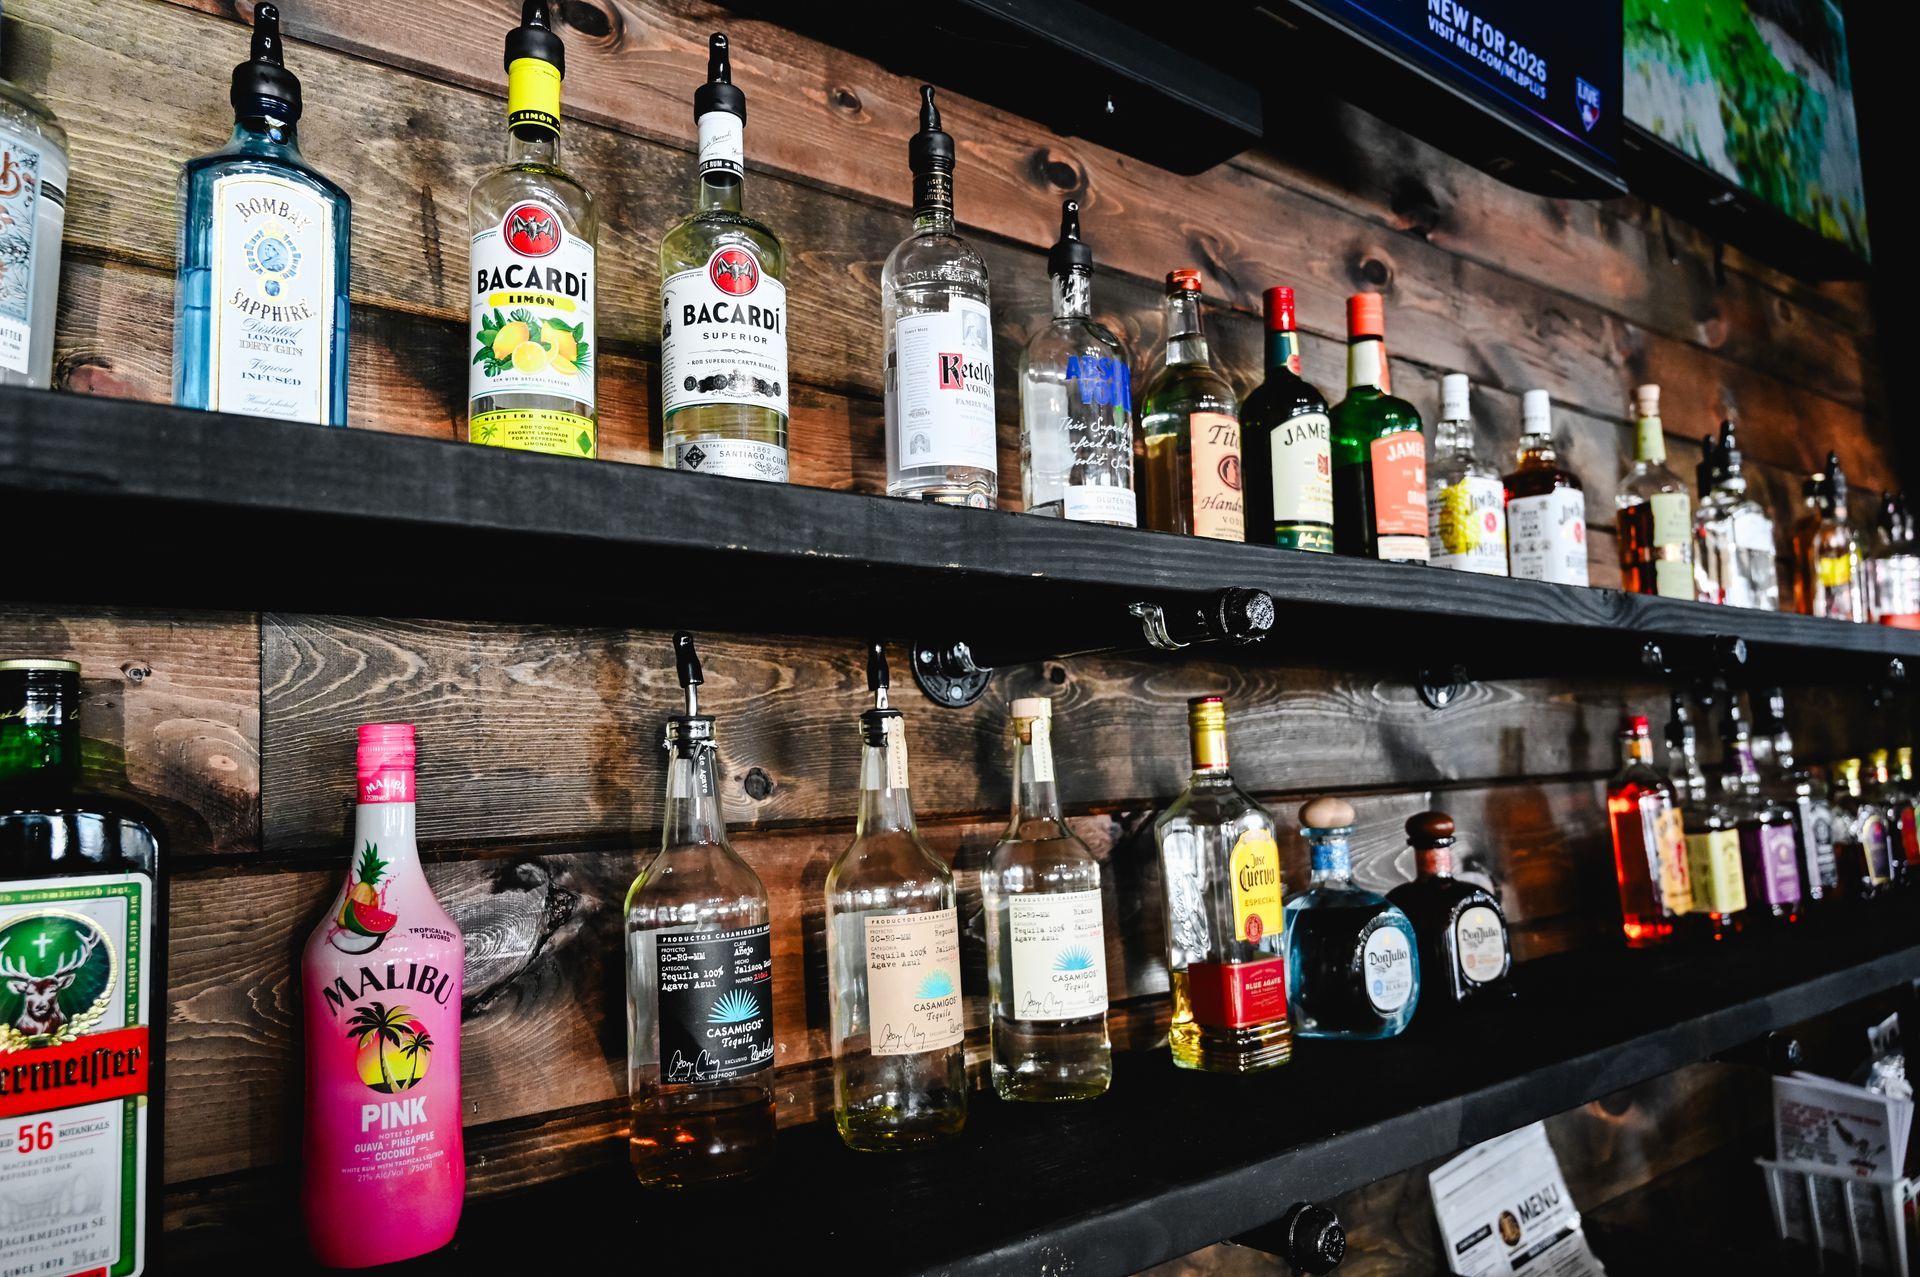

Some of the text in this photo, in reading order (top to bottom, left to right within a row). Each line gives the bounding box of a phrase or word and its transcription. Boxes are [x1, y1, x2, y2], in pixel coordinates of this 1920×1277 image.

[1428, 0, 1547, 82] NEW FOR 2026
[1428, 15, 1546, 99] VISIT MLB.COM/MLBPLUS
[1577, 82, 1600, 108] LIVE
[235, 197, 312, 233] BOMBAY
[229, 288, 312, 322] SAPPHIRE
[509, 295, 555, 307] LIMÓN
[248, 333, 297, 345] LONDON
[703, 332, 768, 345] SUPERIOR
[239, 340, 303, 356] DRY GIN
[242, 371, 302, 386] INFUSED
[940, 355, 984, 387] Ketel
[485, 414, 507, 422] MADE
[537, 431, 569, 439] LEMONADE
[1284, 423, 1330, 446] JAME
[720, 450, 765, 460] SANTIAGO
[365, 779, 407, 795] MALIBU
[1239, 865, 1275, 892] Cuervo
[1244, 897, 1276, 907] ESPECIAL
[871, 916, 916, 925] PRODUCTOS
[421, 933, 450, 942] FLAVORED
[663, 934, 712, 943] PRODUCTOS
[715, 928, 755, 939] CASAMIGOS
[734, 946, 754, 956] Añejo
[871, 946, 927, 961] Tequila 100%
[871, 961, 897, 970] Agave
[662, 965, 724, 982] Tequila 100%
[1052, 971, 1097, 983] CASAMIGOS
[322, 963, 455, 1017] MALIBU
[662, 980, 717, 992] Agave Azul
[1245, 976, 1282, 991] BLUE AGAVE
[913, 996, 957, 1012] CASAMIGOS
[926, 1009, 951, 1022] Tequila
[706, 1021, 762, 1038] CASAMIGOS
[721, 1033, 753, 1049] Tequila
[0, 1047, 141, 1096] ermeister
[362, 1095, 428, 1133] PINK
[18, 1121, 54, 1154] 56
[59, 1121, 110, 1138] BOTANICALS
[354, 1131, 435, 1153] GUAVA PINEAPPLE
[379, 1132, 402, 1140] NOTES
[375, 1146, 416, 1161] COCONUT
[1517, 1183, 1560, 1224] MENU
[92, 1216, 107, 1226] SE
[3, 1257, 64, 1277] SINCE 1878
